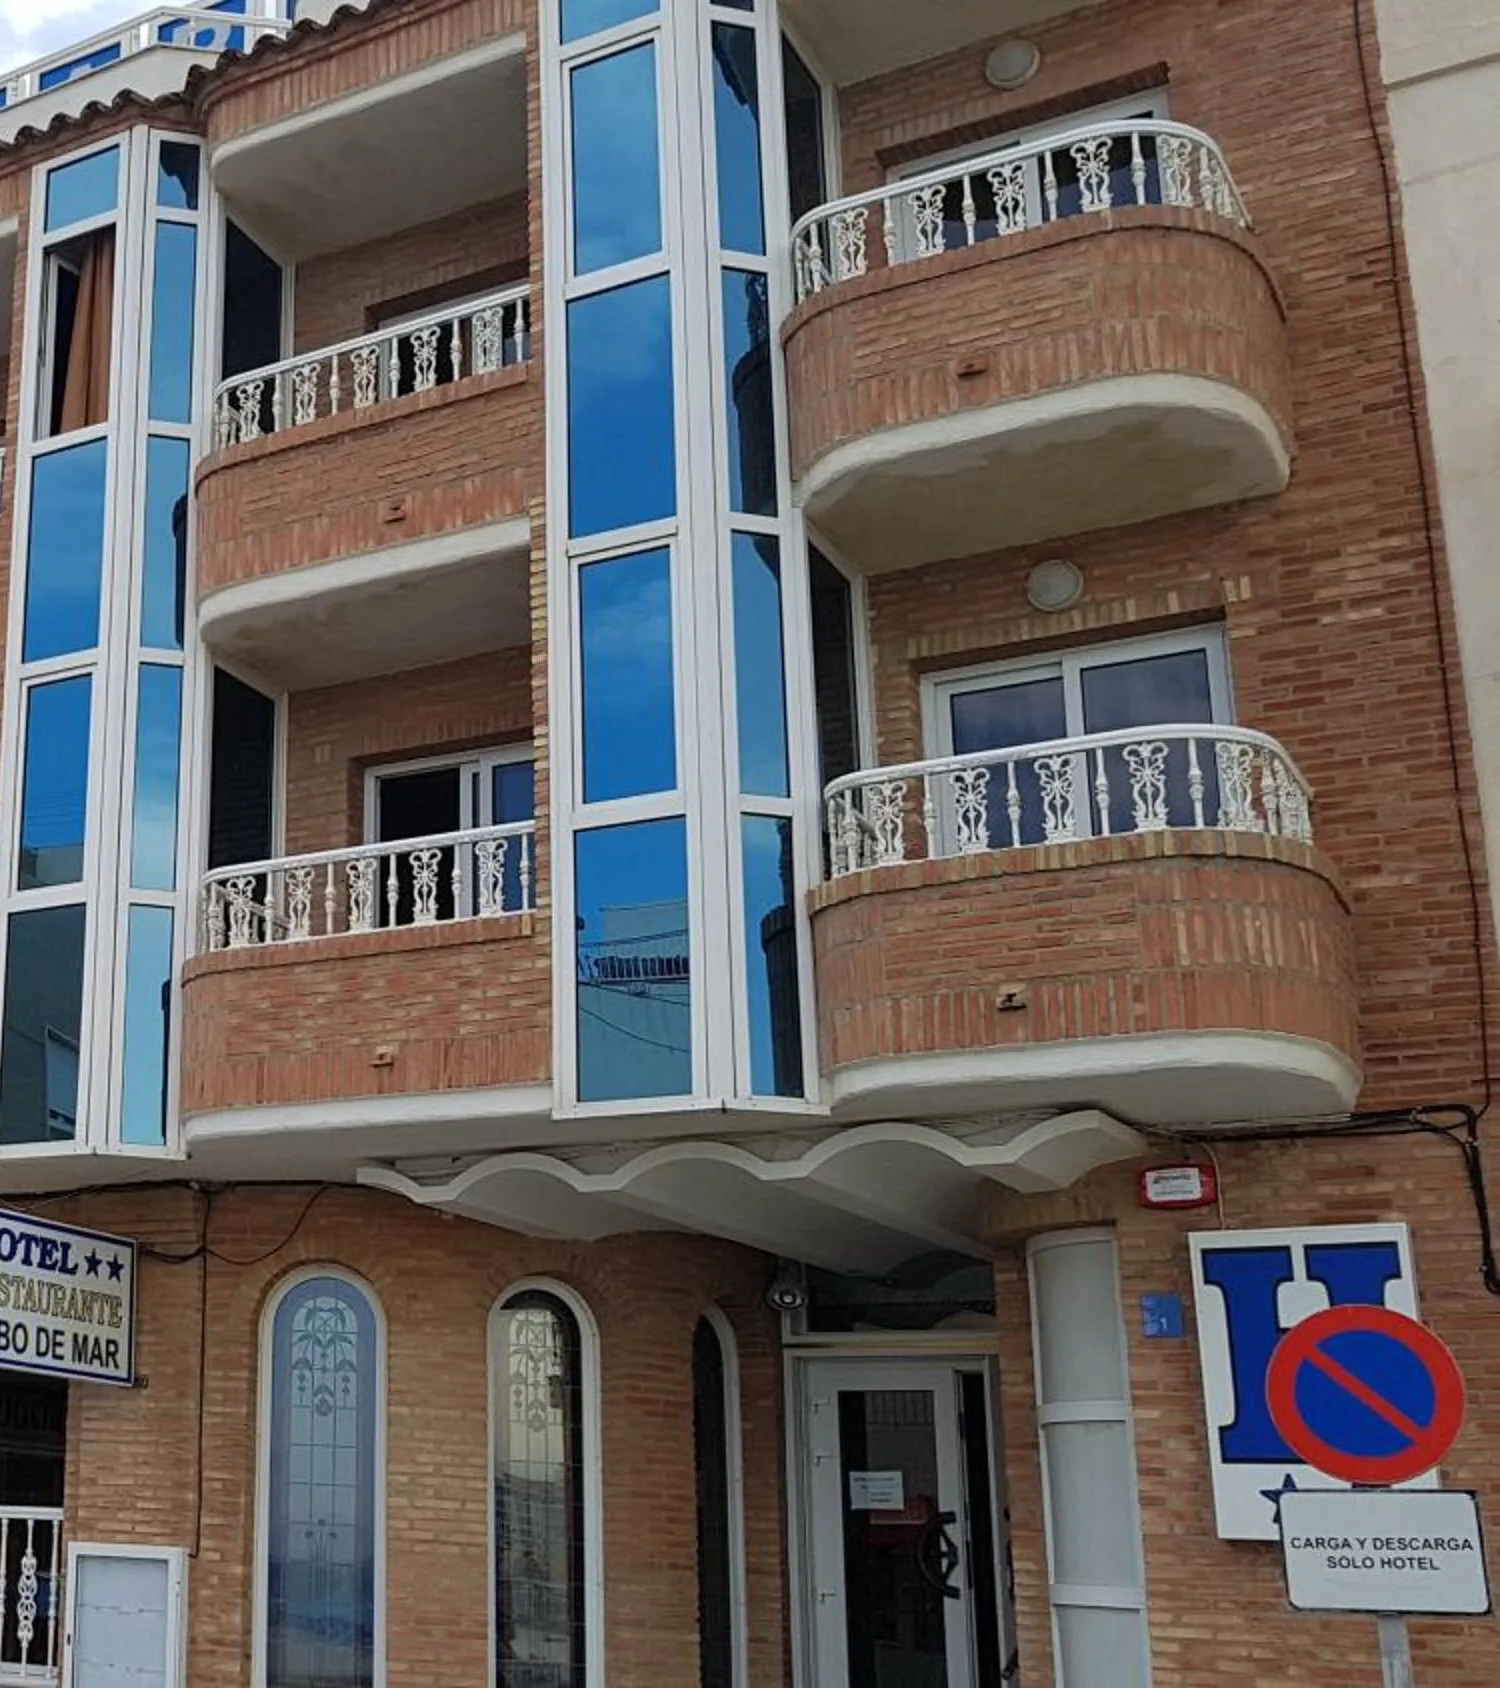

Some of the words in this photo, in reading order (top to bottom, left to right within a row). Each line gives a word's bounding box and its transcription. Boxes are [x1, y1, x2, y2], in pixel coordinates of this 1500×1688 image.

[35, 1326, 65, 1360] DE
[72, 1332, 119, 1370] MAR
[1289, 1537, 1351, 1551] CARGA
[1355, 1537, 1368, 1550] Y
[1372, 1537, 1474, 1551] DESCARGA
[1326, 1555, 1375, 1569] SOLO
[1380, 1556, 1441, 1571] HOTEL
